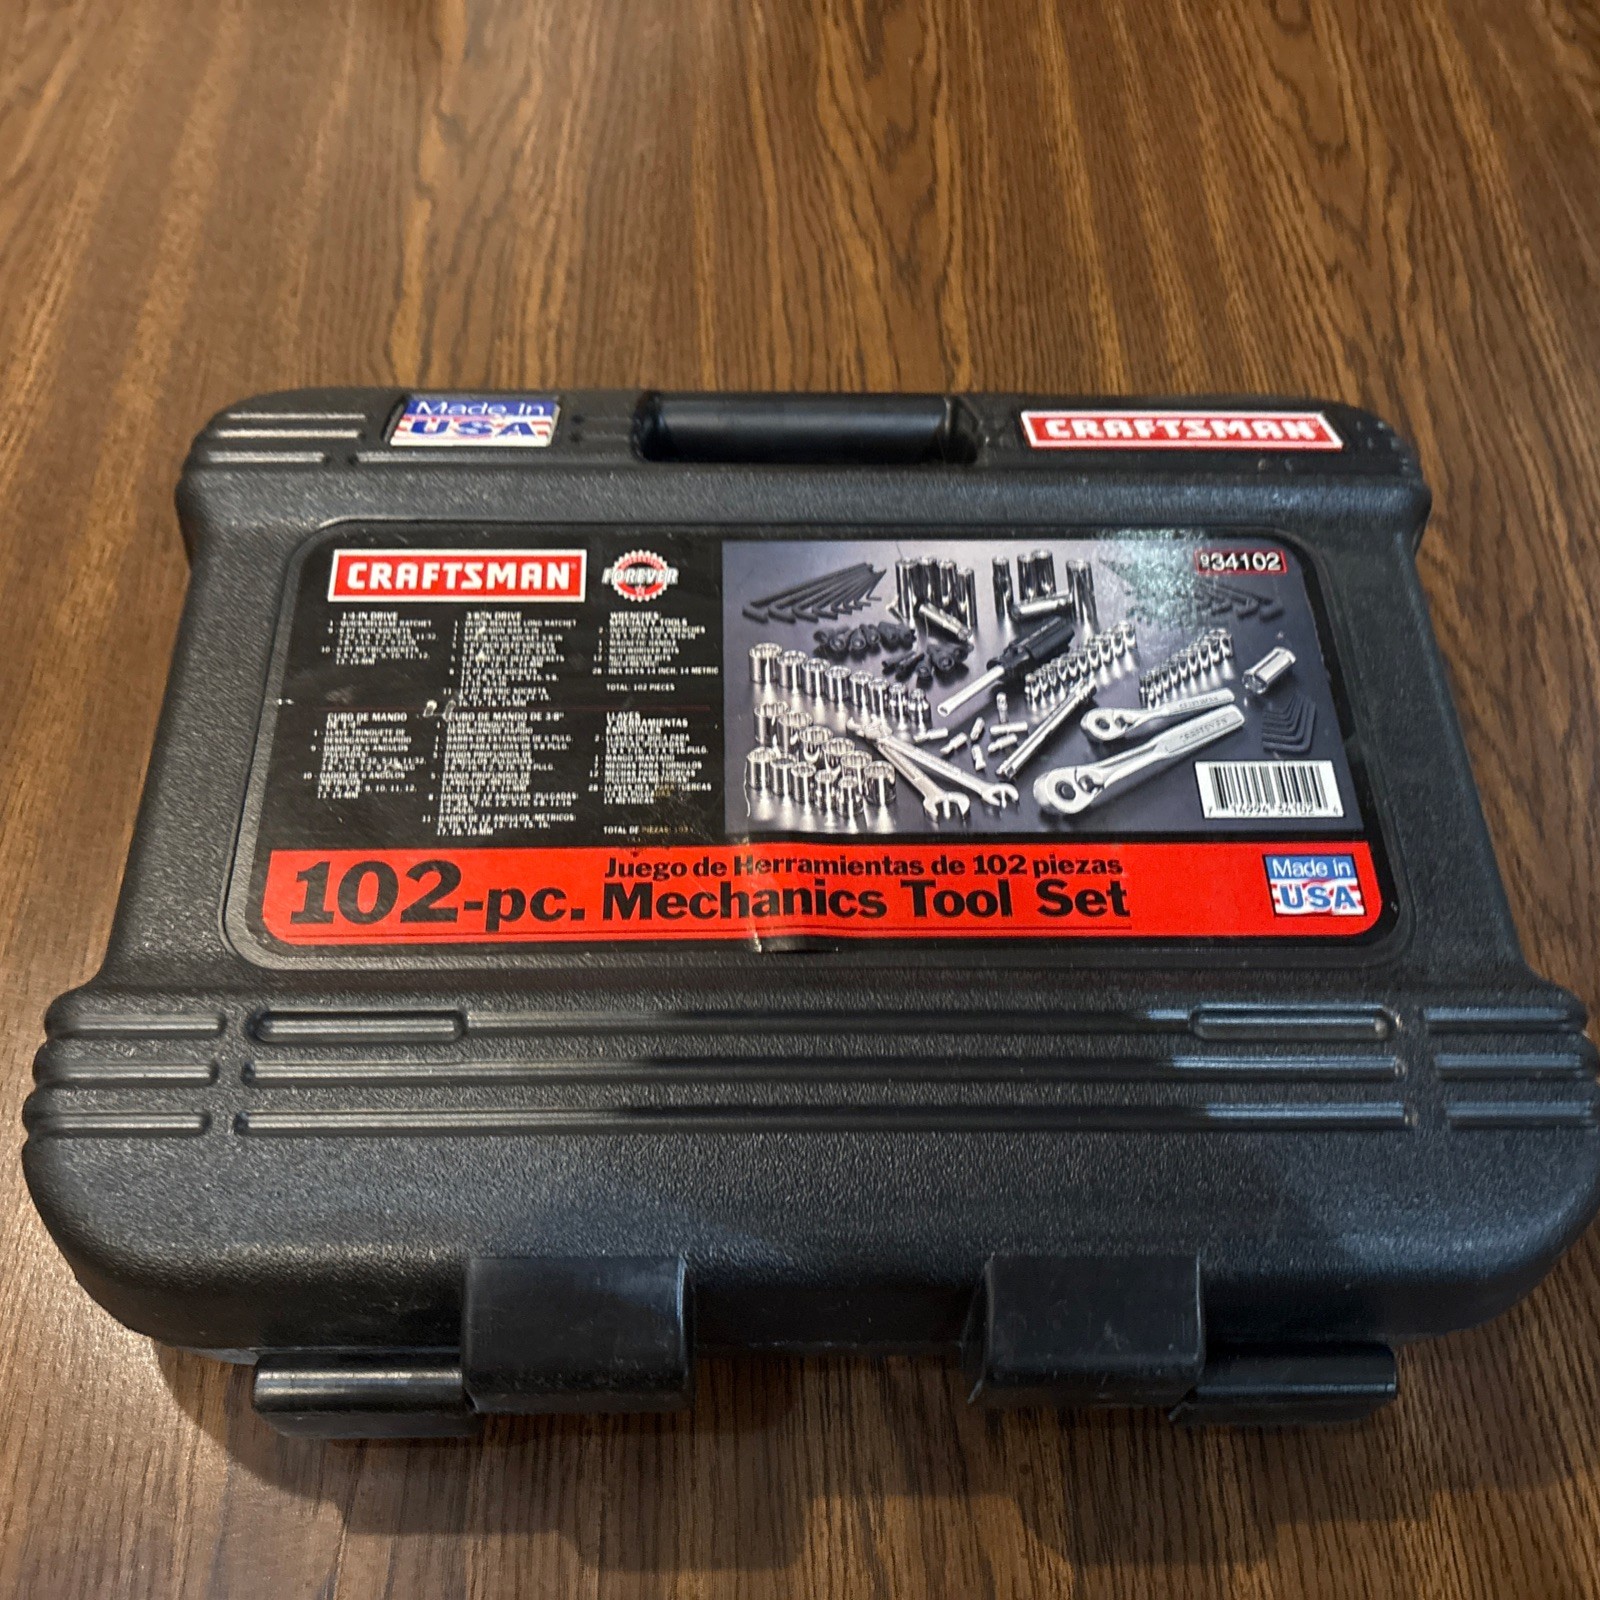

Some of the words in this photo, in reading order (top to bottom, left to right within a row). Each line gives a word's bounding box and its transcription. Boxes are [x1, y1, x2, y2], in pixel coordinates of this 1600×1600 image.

[416, 401, 507, 415] Made
[518, 402, 544, 415] In
[410, 420, 535, 436] USA
[1045, 418, 1316, 440] CRAFTSMAN
[347, 562, 571, 590] CRAFTSMAN
[601, 566, 679, 585] FOREVER
[371, 712, 408, 722] MANDO
[492, 711, 528, 721] MANDO
[605, 858, 687, 882] Juego
[692, 857, 727, 877] de
[733, 856, 925, 877] Herramientas
[930, 855, 963, 876] de
[973, 855, 1028, 876] 102
[1033, 855, 1123, 879] piezas
[1273, 858, 1328, 877] Made
[1333, 858, 1351, 876] In
[290, 860, 586, 933] 102-pc.
[603, 880, 887, 921] Mechanics
[901, 879, 1014, 919] Tool
[1035, 879, 1131, 918] Set
[1280, 886, 1357, 908] USA
